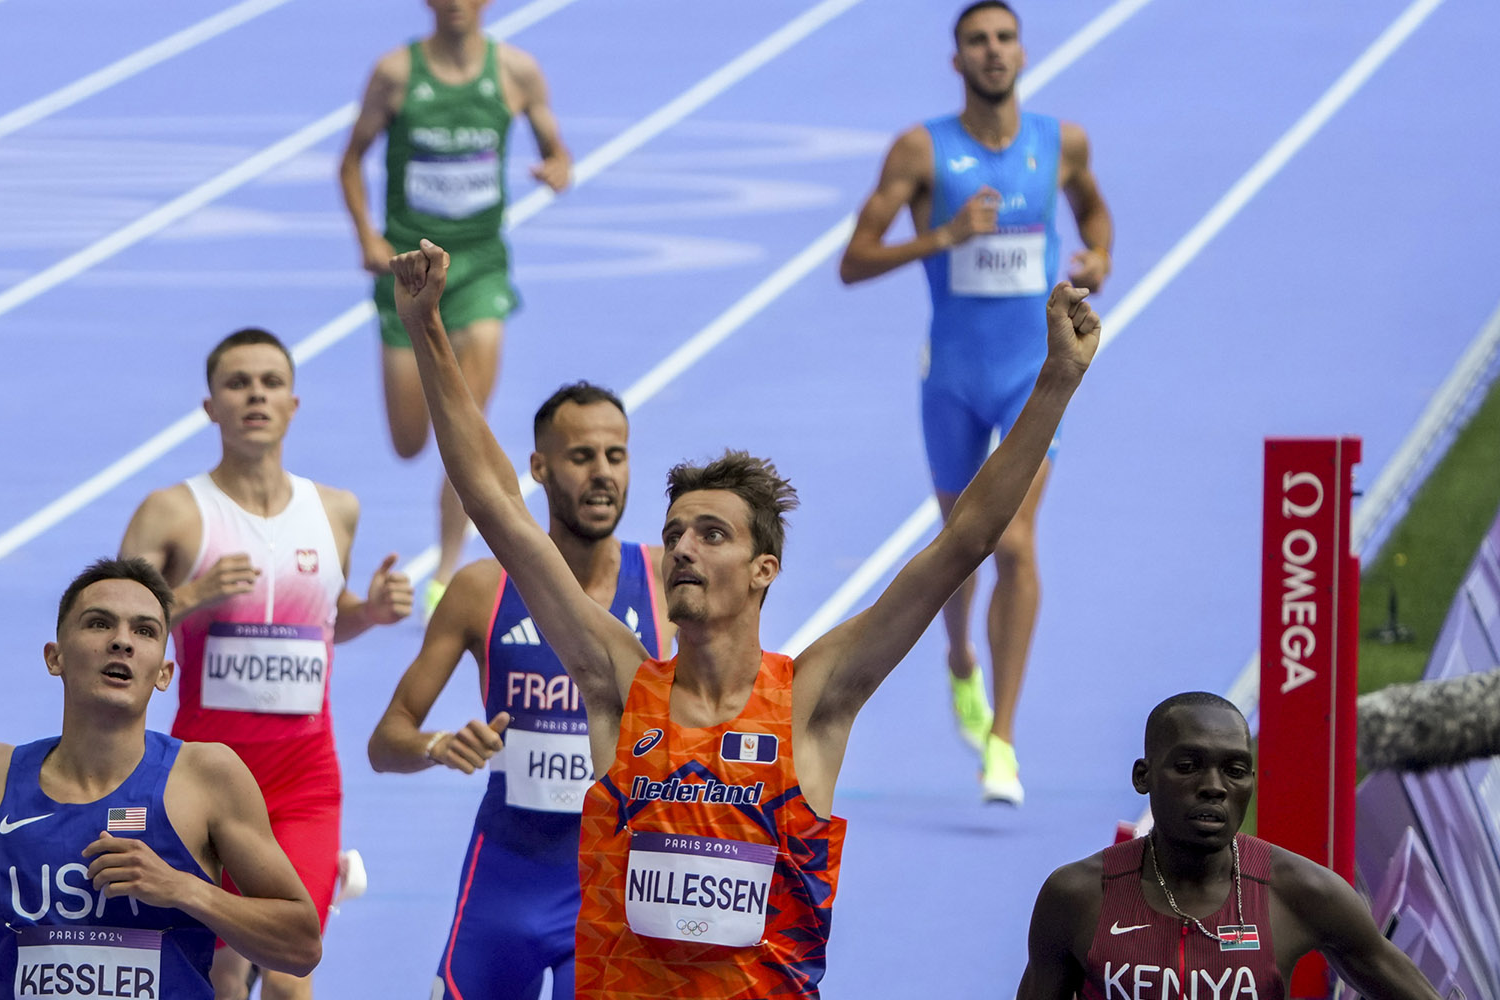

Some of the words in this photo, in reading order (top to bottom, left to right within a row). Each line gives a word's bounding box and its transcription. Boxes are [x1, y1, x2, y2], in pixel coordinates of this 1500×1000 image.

[1280, 528, 1318, 694] OMEGA
[207, 653, 323, 683] WYDERKA
[536, 720, 568, 731] PARIS
[528, 750, 595, 781] HAB
[665, 838, 700, 850] PARIS
[705, 841, 739, 855] 2024
[628, 869, 767, 914] NILLESSEN
[49, 930, 85, 941] PARIS
[90, 931, 123, 942] 2024
[20, 963, 155, 999] KESSLER
